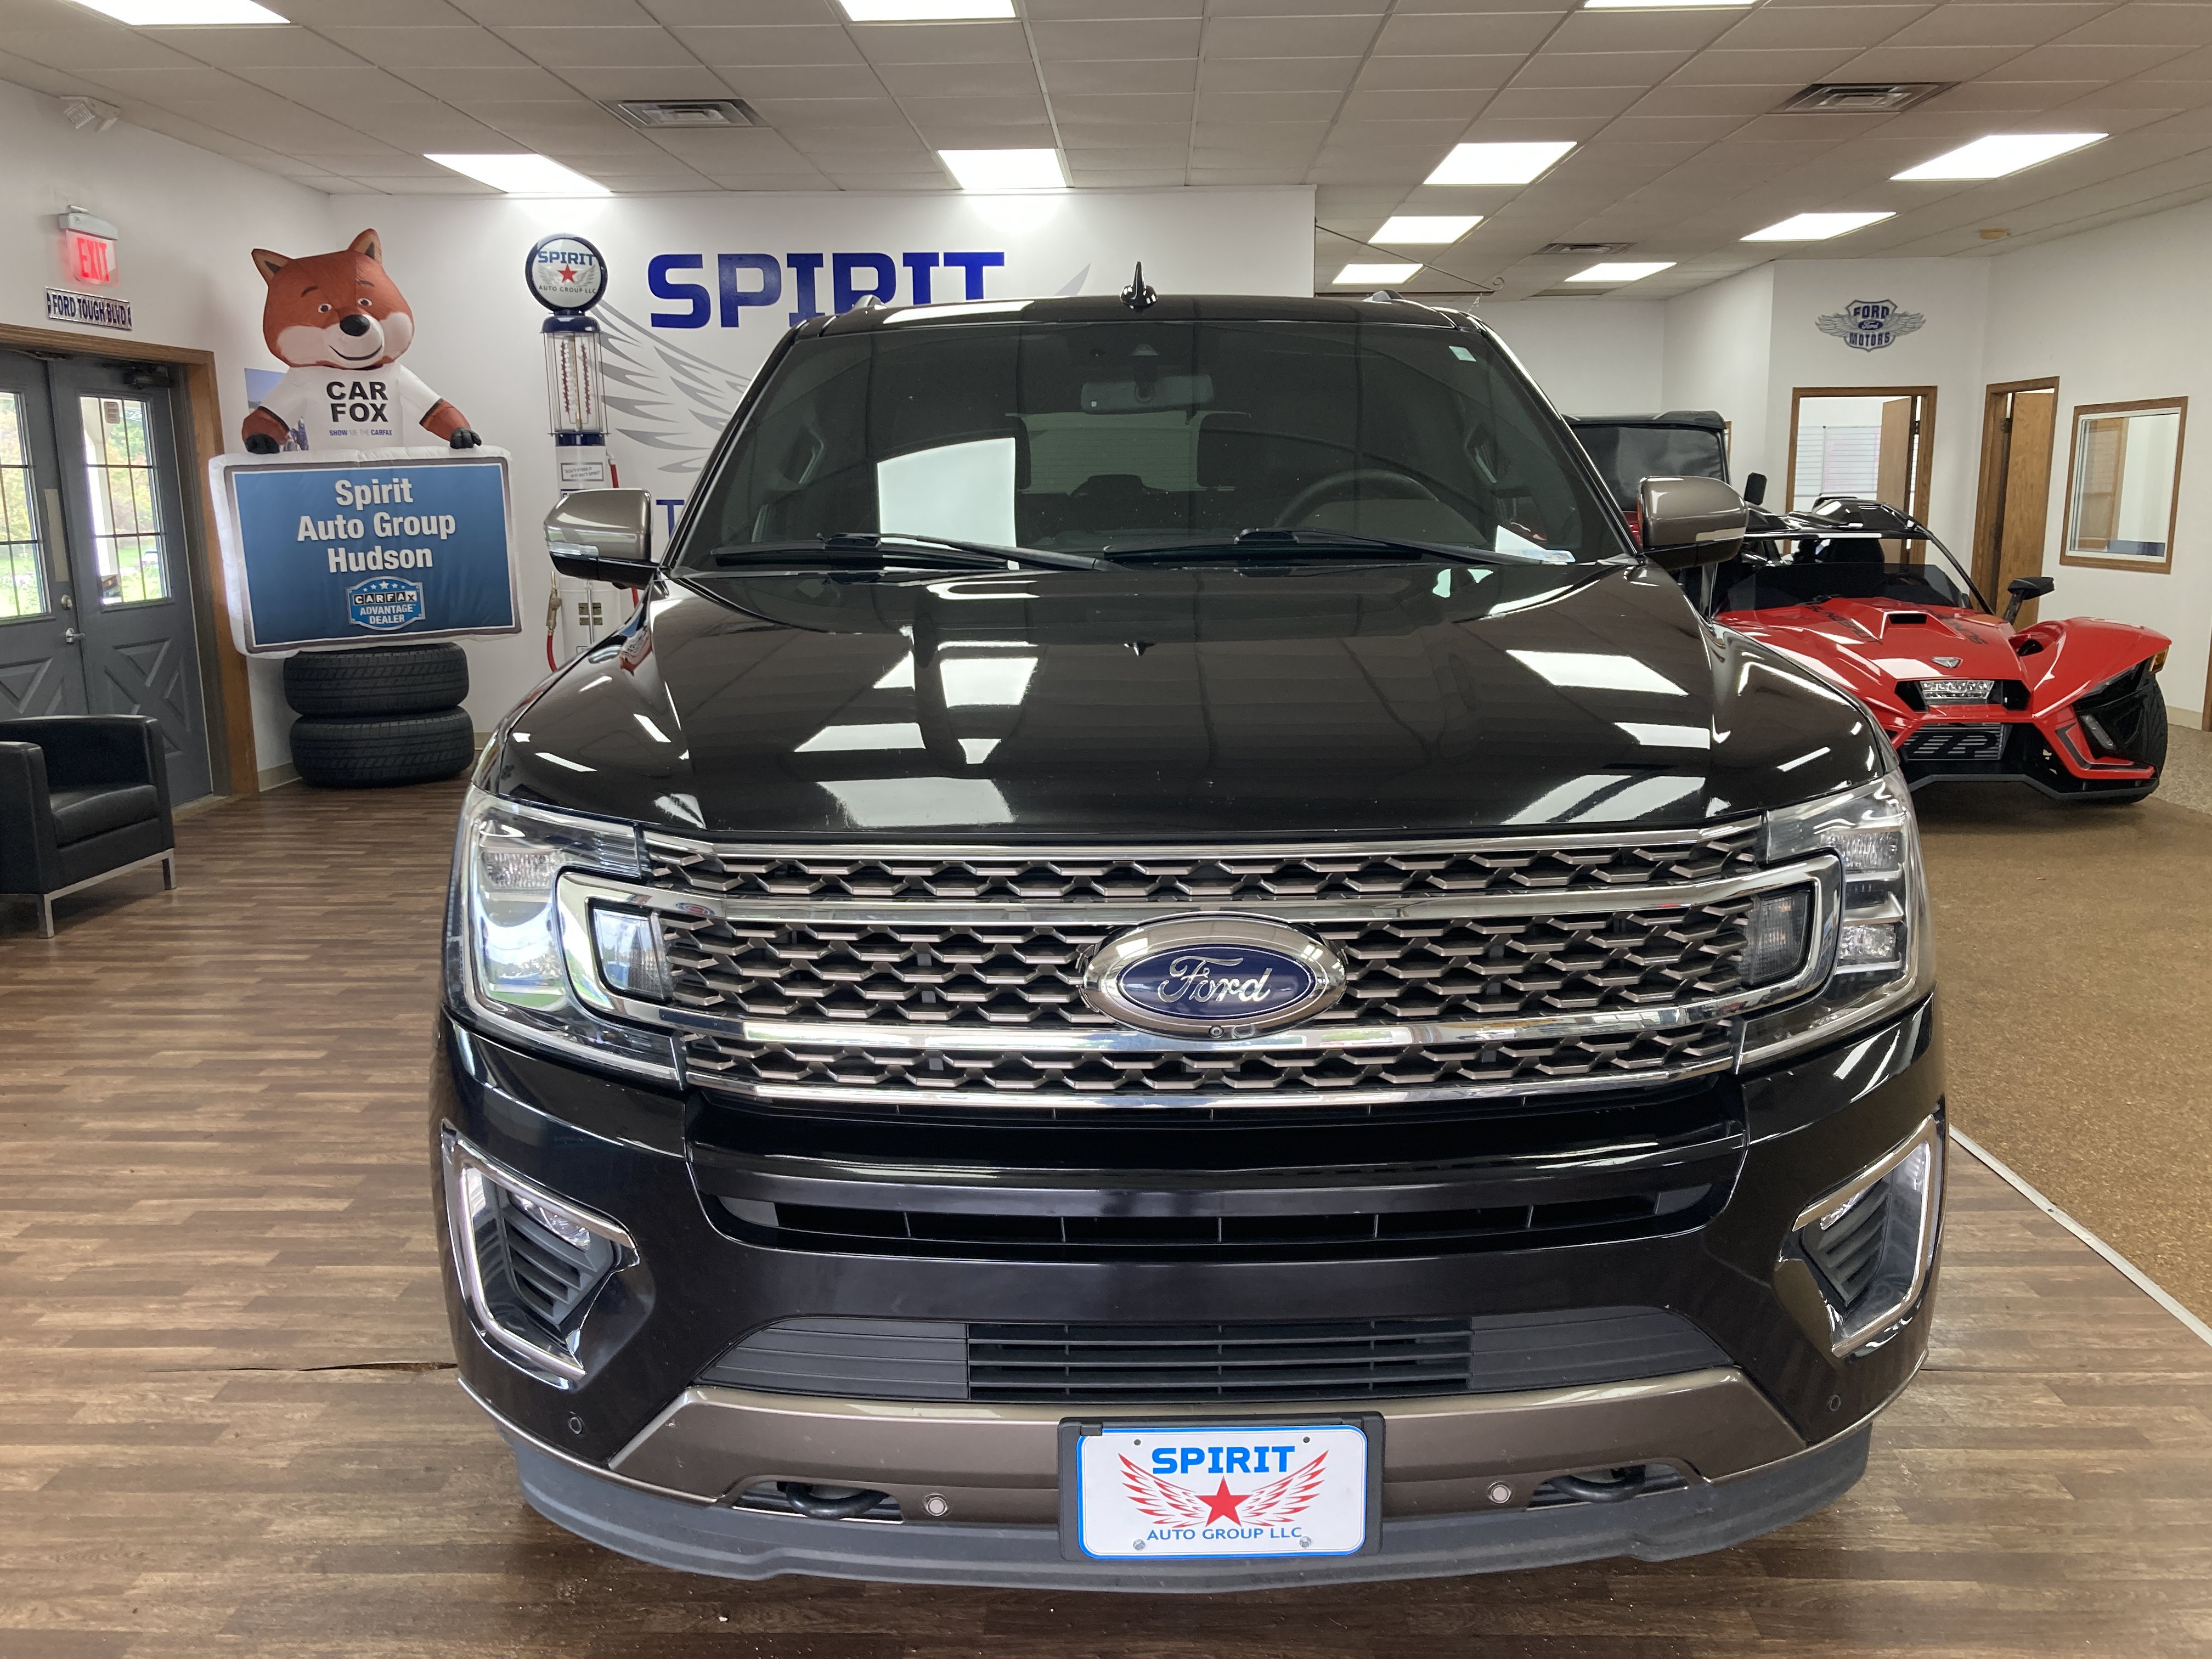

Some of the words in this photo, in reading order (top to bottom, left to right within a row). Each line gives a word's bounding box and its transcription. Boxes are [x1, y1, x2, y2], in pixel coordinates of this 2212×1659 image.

[77, 237, 109, 281] EXIT
[538, 251, 595, 266] SPIRIT
[648, 251, 1005, 329] SPIRIT
[52, 294, 76, 317] FORD
[77, 297, 106, 322] TOUGH
[106, 303, 126, 325] BLVD
[1853, 304, 1890, 319] FORD
[1861, 321, 1880, 329] Ford
[1849, 331, 1891, 347] MOTORS
[326, 381, 388, 400] CAR
[330, 403, 388, 422] FOX
[334, 477, 414, 511] Spirit
[297, 515, 365, 542] Auto
[374, 511, 456, 540] Group
[327, 545, 433, 573] Hudson
[354, 591, 416, 605] CARFAX
[359, 604, 414, 616] ADVANTAGE
[369, 614, 405, 624] DEALER
[1157, 955, 1273, 1004] Ford
[1152, 1445, 1296, 1475] SPIRIT
[1147, 1528, 1196, 1541] AUTO
[1201, 1528, 1265, 1540] GROUP
[1270, 1527, 1302, 1539] LLC
